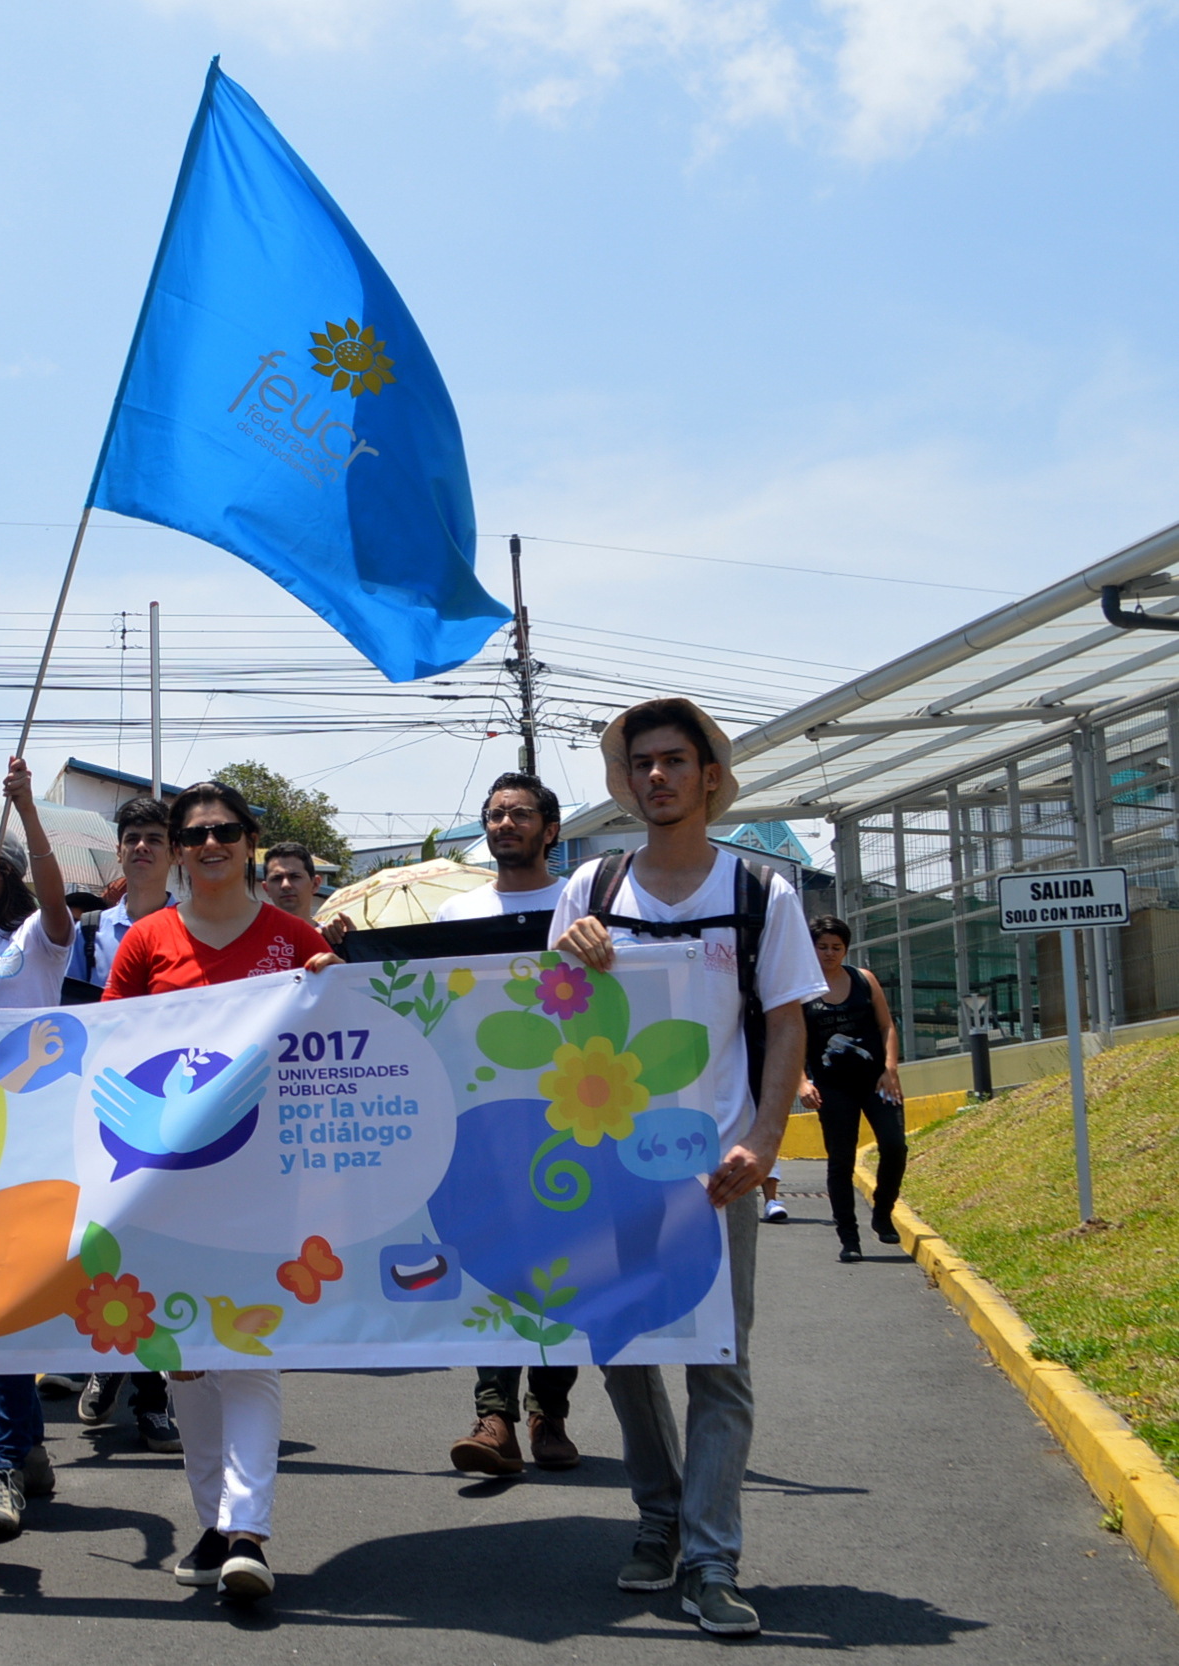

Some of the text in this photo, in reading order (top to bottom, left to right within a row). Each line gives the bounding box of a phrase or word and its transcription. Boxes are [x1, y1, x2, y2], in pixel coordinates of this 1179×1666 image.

[228, 350, 380, 469] feucr
[236, 420, 325, 489] de estudiantes
[244, 403, 340, 483] federación
[1030, 879, 1094, 901] SALIDA
[1005, 903, 1123, 924] SOLO CON TARJETA
[704, 942, 736, 960] UN
[277, 1029, 370, 1063] 2017
[278, 1064, 409, 1081] UNIVERSIDADES
[279, 1082, 358, 1097] PÚBLICAS
[278, 1094, 419, 1125] por la vida
[279, 1121, 413, 1146] el diálogo
[279, 1148, 382, 1175] y la paz
